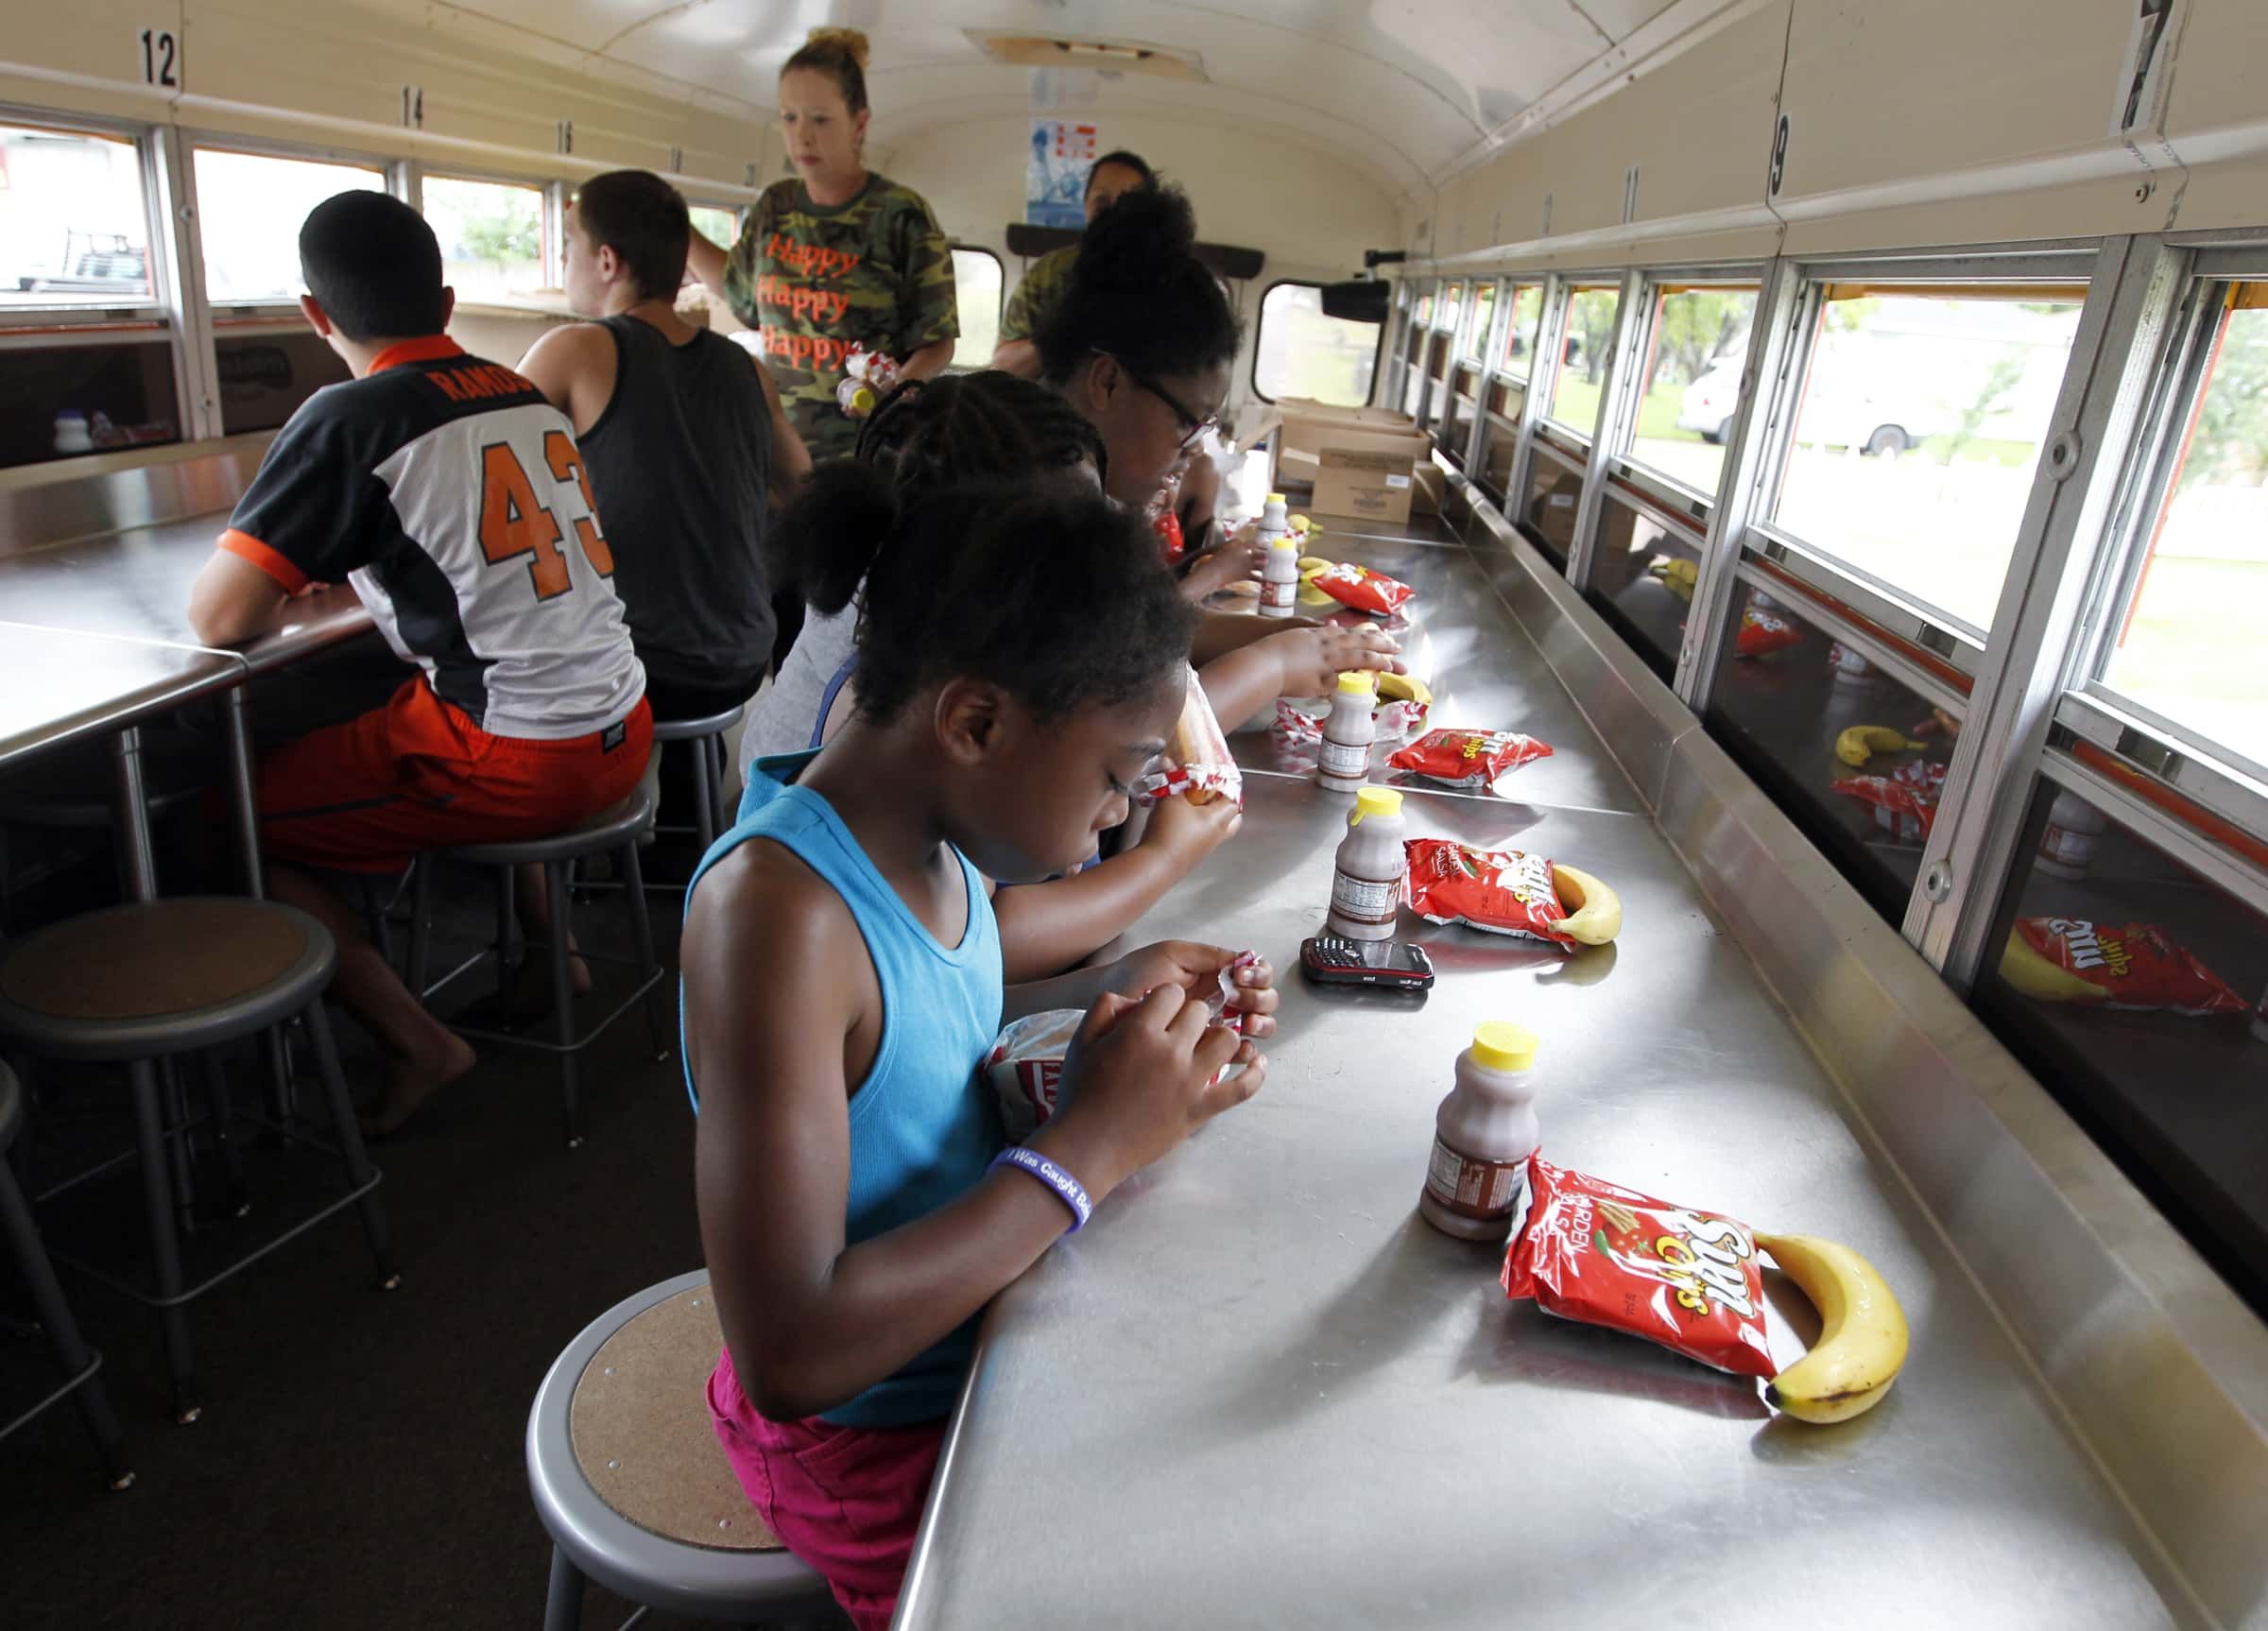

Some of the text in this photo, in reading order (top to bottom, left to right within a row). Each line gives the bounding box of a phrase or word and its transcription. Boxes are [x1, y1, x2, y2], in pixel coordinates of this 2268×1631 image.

[142, 28, 176, 87] 12
[403, 85, 422, 129] 14
[1771, 114, 1789, 197] 9
[766, 232, 860, 279] Happy
[757, 274, 850, 324] Happy
[759, 322, 850, 372] Happy
[478, 430, 614, 603] 43
[1462, 734, 1486, 760] hips
[1435, 848, 1446, 878] SALSA
[1013, 1149, 1039, 1168] Was
[1040, 1161, 1078, 1198] Caught
[1665, 1208, 1755, 1319] Sun
